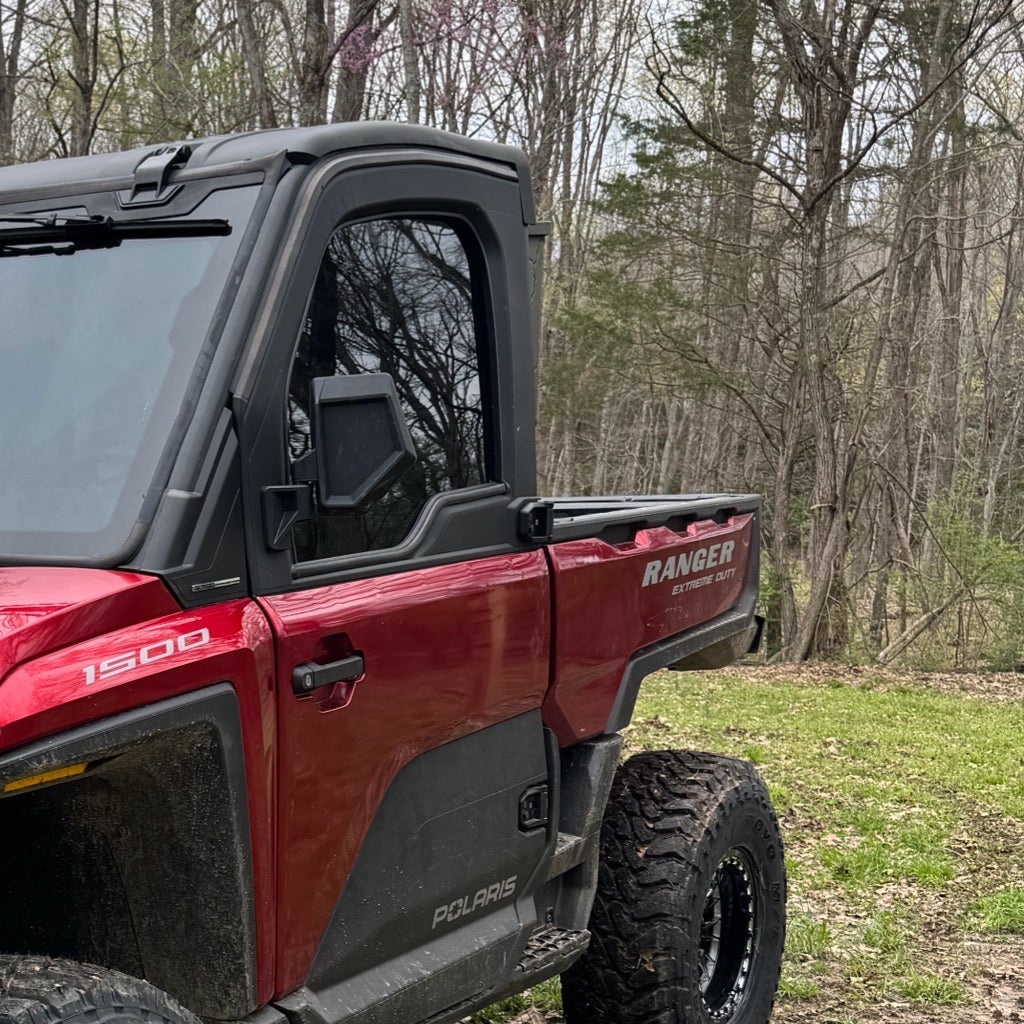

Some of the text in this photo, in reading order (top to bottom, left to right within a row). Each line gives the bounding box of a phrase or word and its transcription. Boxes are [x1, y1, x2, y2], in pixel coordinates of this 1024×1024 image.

[641, 540, 735, 588] RANGER
[672, 567, 737, 596] EXTREME DUTY
[82, 627, 210, 685] 1500
[431, 875, 518, 930] POLARIS
